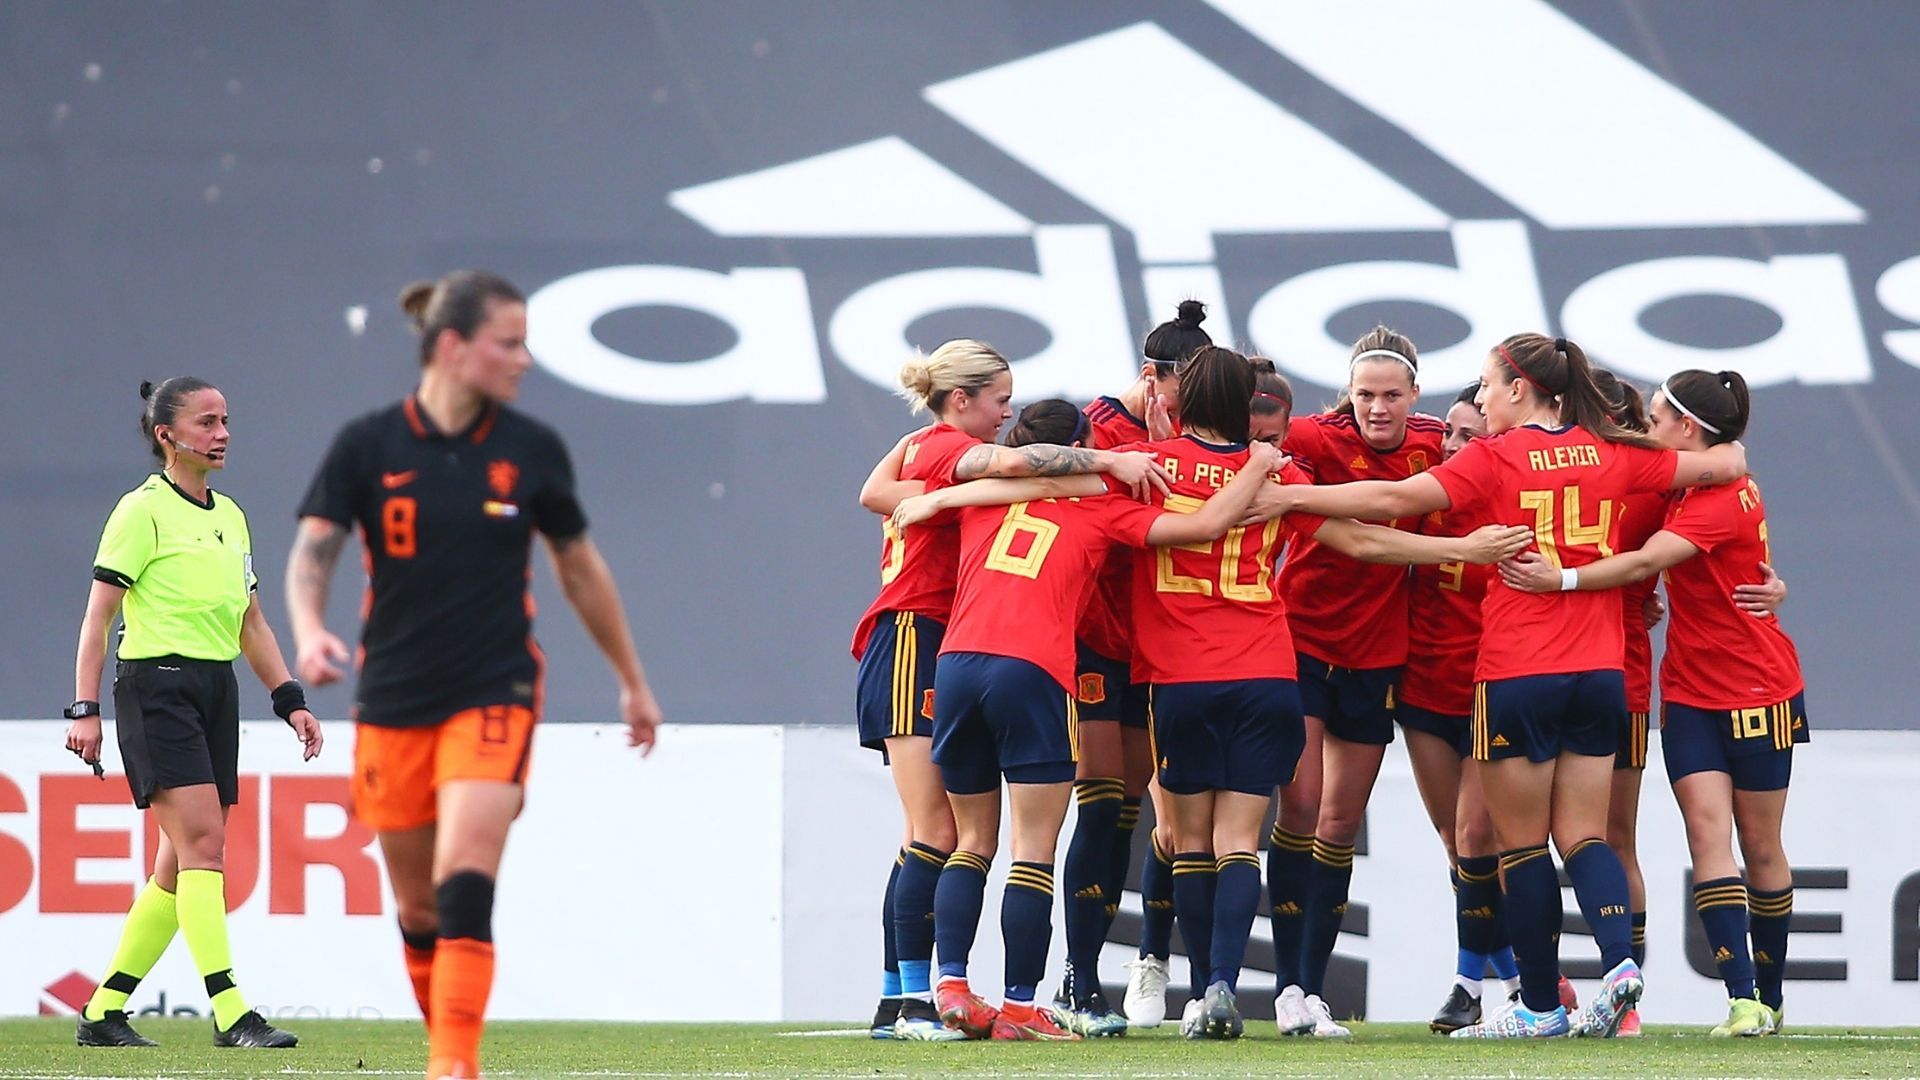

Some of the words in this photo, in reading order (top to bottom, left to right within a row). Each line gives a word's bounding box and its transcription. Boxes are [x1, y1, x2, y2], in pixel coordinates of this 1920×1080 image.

[1528, 445, 1601, 471] ALEXIA
[382, 496, 417, 560] 8
[984, 501, 1061, 580] 6
